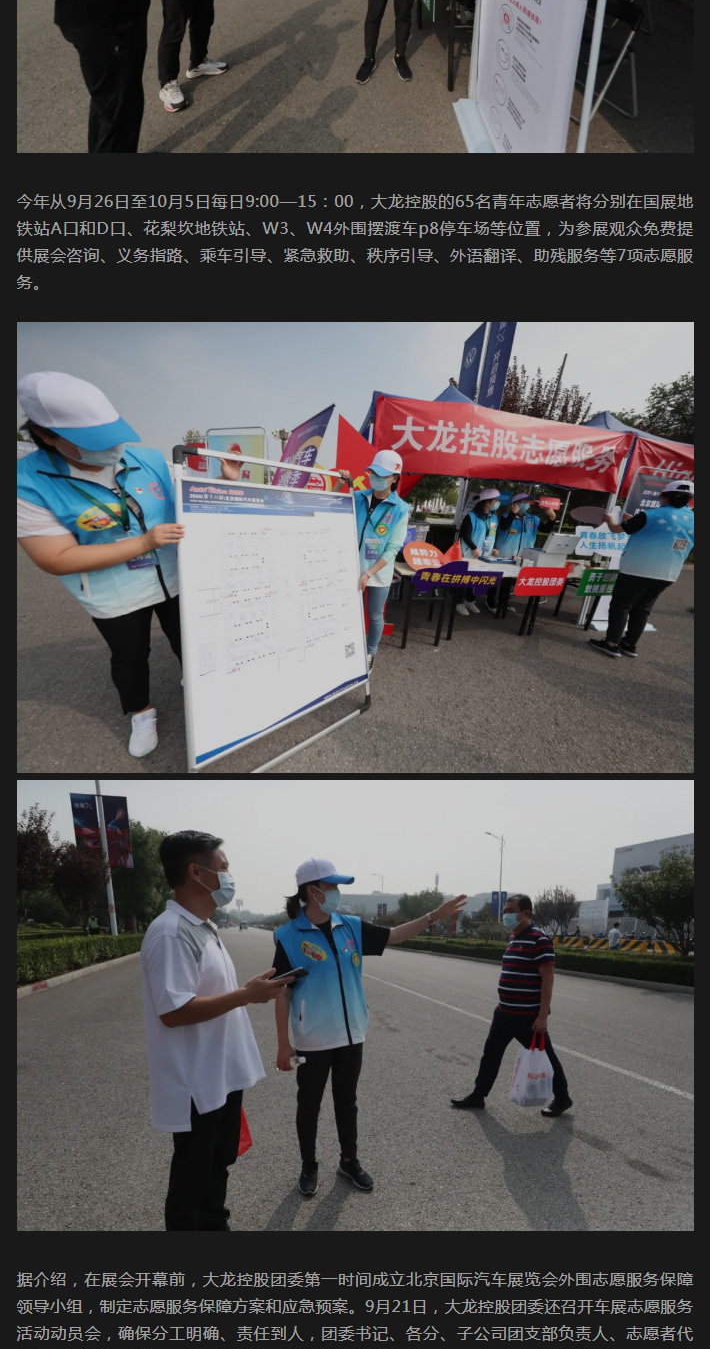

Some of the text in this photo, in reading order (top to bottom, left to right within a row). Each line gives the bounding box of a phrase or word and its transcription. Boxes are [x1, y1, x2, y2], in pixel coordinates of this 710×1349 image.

[17, 220, 694, 238] 铁站A口和D口、花梨坎地铁站、W3、W4外围摆渡车p8停车场等位置，为参展观众免费提
[17, 248, 694, 264] 供展会咨询、义务指路、乘车引导、紧急救助、秩序引导、外语翻译、助残服务等7项志愿服
[17, 275, 40, 291] 务。
[391, 416, 618, 475] 大龙控股志愿服务
[580, 531, 631, 542] 青春放飞梦
[410, 547, 439, 558] 越努力
[420, 571, 498, 586] 青春在拼搏中闪光
[518, 577, 565, 587] 大龙控股团委
[17, 1271, 694, 1288] 据介绍，在展会开幕前，大龙控股团委第一时间成立北京国际汽车展览会外围志愿服务保障
[17, 1298, 694, 1314] 领导小组，制定志愿服务保障方案和应急预案。9月21日，大龙控股团委还召开车展志愿服务
[17, 1325, 694, 1342] 活动动员会，确保分工明确、责任到人，团委书记、各分、子公司团支部负责人、志愿者代
